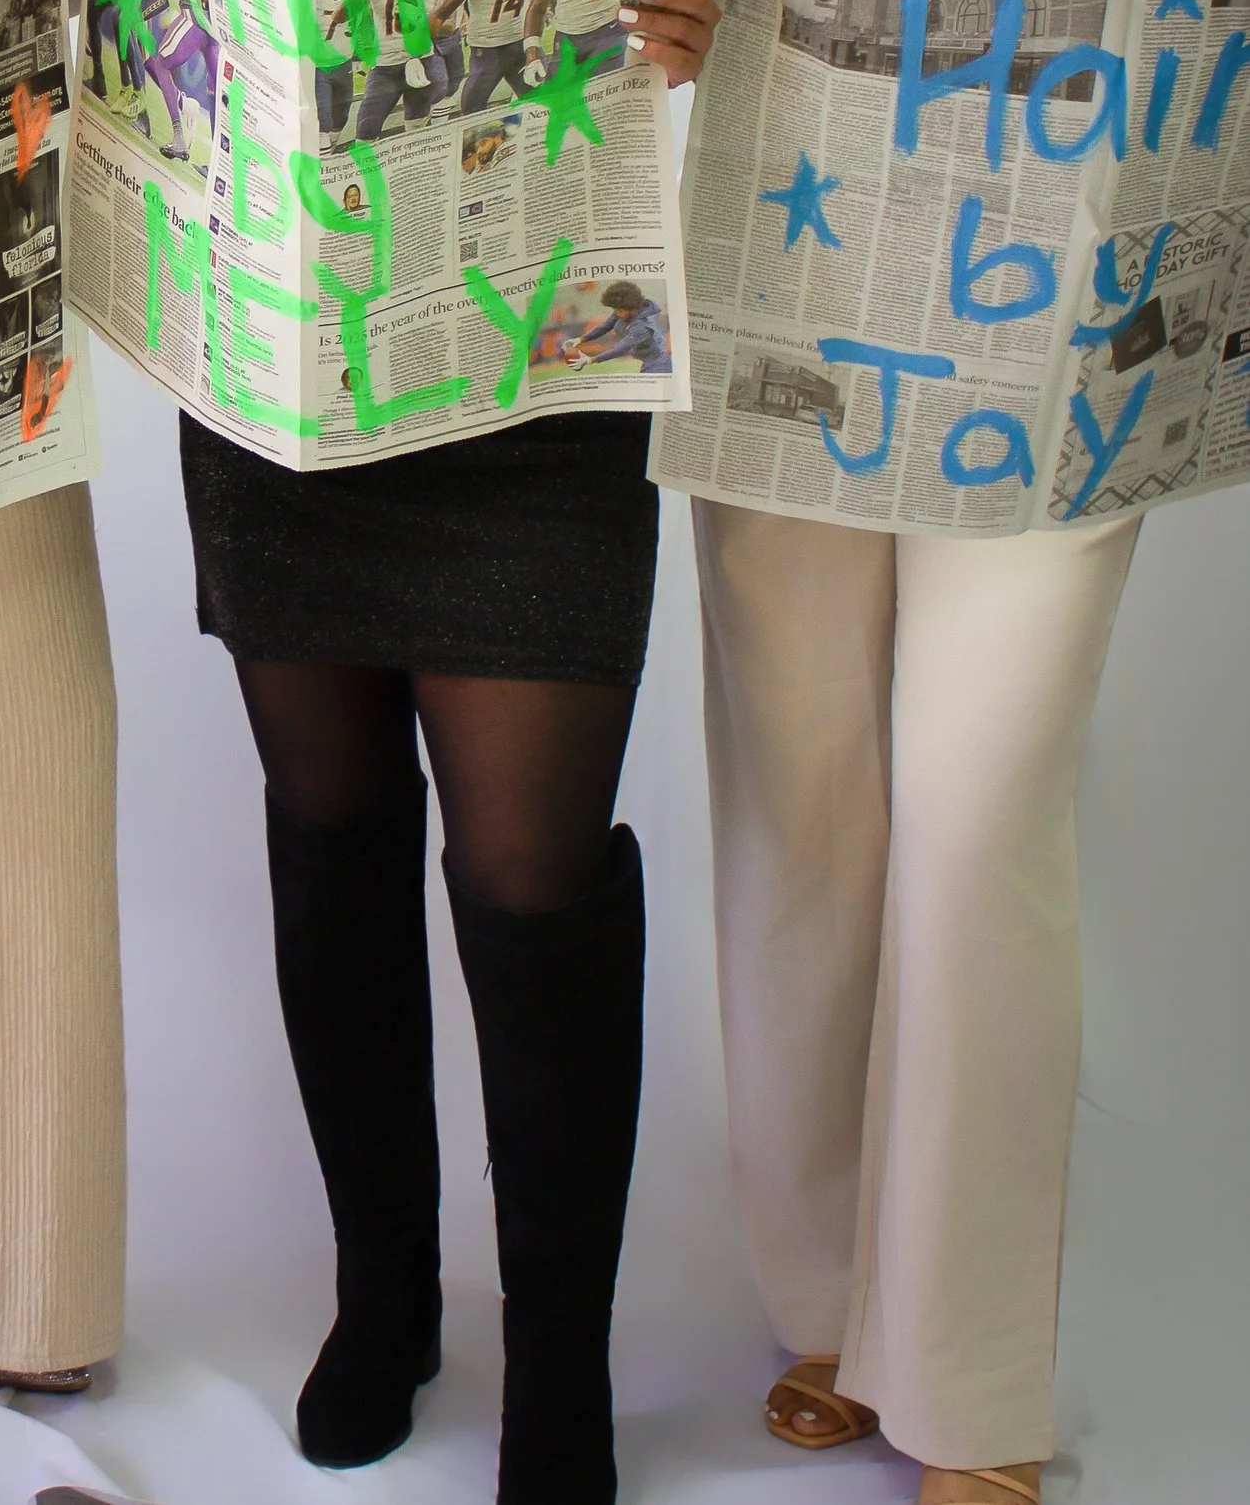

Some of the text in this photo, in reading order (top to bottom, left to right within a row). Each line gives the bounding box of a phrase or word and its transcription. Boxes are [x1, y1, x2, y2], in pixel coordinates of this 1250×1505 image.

[606, 85, 619, 101] for
[622, 78, 650, 93] DEs?
[76, 132, 113, 178] Getting
[115, 164, 141, 195] their
[321, 165, 341, 175] Here
[342, 162, 354, 171] are
[392, 144, 401, 154] for
[404, 135, 442, 153] optimism
[321, 176, 336, 185] and
[338, 174, 342, 182] 3
[388, 156, 399, 166] for
[428, 142, 451, 154] hopes
[4, 231, 53, 266] felonious
[11, 250, 50, 278] florida
[1127, 233, 1223, 273] A STORIC
[1192, 244, 1230, 265] GIFT
[949, 194, 1173, 347] by
[319, 336, 334, 347] Is
[370, 322, 389, 337] the
[391, 313, 416, 331] year
[418, 305, 431, 319] of
[433, 301, 454, 316] the
[575, 265, 587, 278] in
[590, 265, 614, 281] pro
[618, 261, 665, 276] sports?
[710, 323, 804, 348] Bros plans shelved
[959, 375, 1039, 391] safety concerns
[818, 337, 1153, 521] Jay
